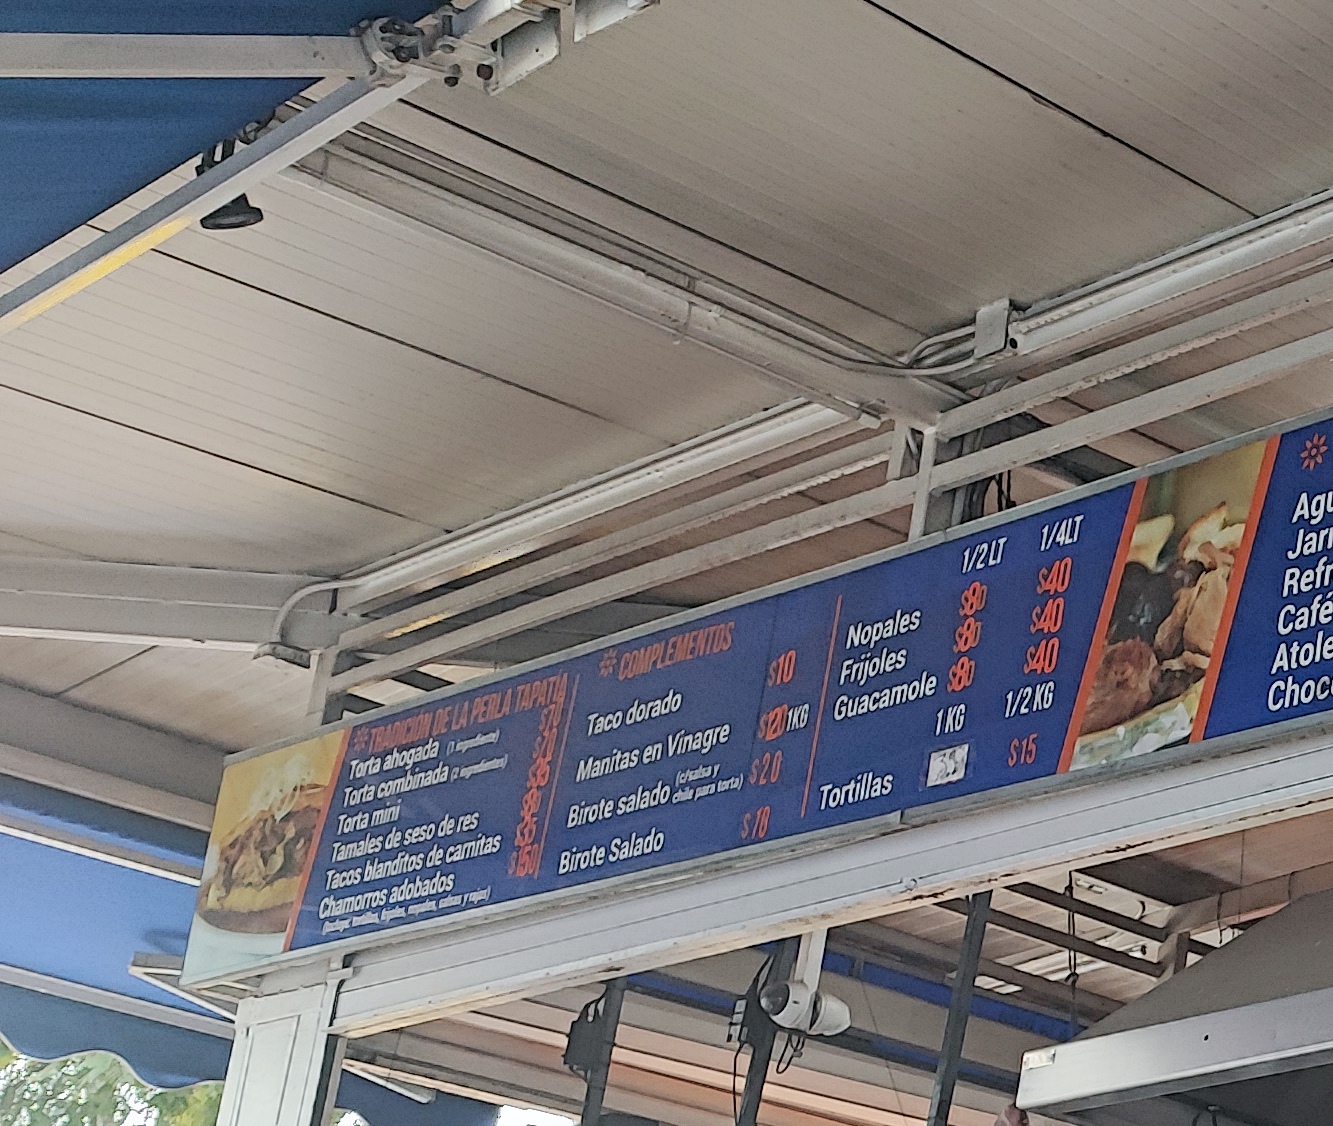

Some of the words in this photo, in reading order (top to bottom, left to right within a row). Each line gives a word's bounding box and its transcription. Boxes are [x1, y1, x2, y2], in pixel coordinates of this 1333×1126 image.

[845, 608, 922, 650] Nopales
[1036, 556, 1073, 596] $40
[1277, 588, 1333, 636] Café
[617, 621, 736, 682] COMPLEMENTOS
[839, 646, 908, 687] Frijoles
[1029, 596, 1065, 635] $40
[833, 671, 938, 722] Guacamole
[1023, 636, 1060, 676] $40
[587, 711, 623, 737] Taco
[625, 688, 683, 726] dorado
[350, 757, 381, 781] Torta
[382, 738, 440, 771] ahogada
[575, 747, 639, 784] Manitas
[642, 741, 663, 767] en
[667, 723, 732, 760] Vinagre
[749, 749, 783, 787] $20
[343, 785, 376, 809] Torta
[376, 761, 450, 799] combinada
[566, 798, 614, 829] Birote
[616, 780, 672, 816] salado
[819, 770, 894, 811] Tortillas
[331, 833, 383, 863] Tamales
[385, 826, 401, 850] de
[403, 821, 436, 845] seso
[437, 814, 454, 838] de
[456, 811, 480, 833] res
[337, 813, 368, 836] Torta
[371, 800, 401, 827] mini
[325, 866, 363, 891] Tacos
[363, 850, 424, 883] blanditos
[426, 844, 444, 868] de
[445, 833, 502, 864] carnitas
[558, 846, 605, 876] Birote
[607, 827, 665, 863] Salado
[318, 887, 389, 920] Chamorros
[389, 871, 456, 903] adobados
